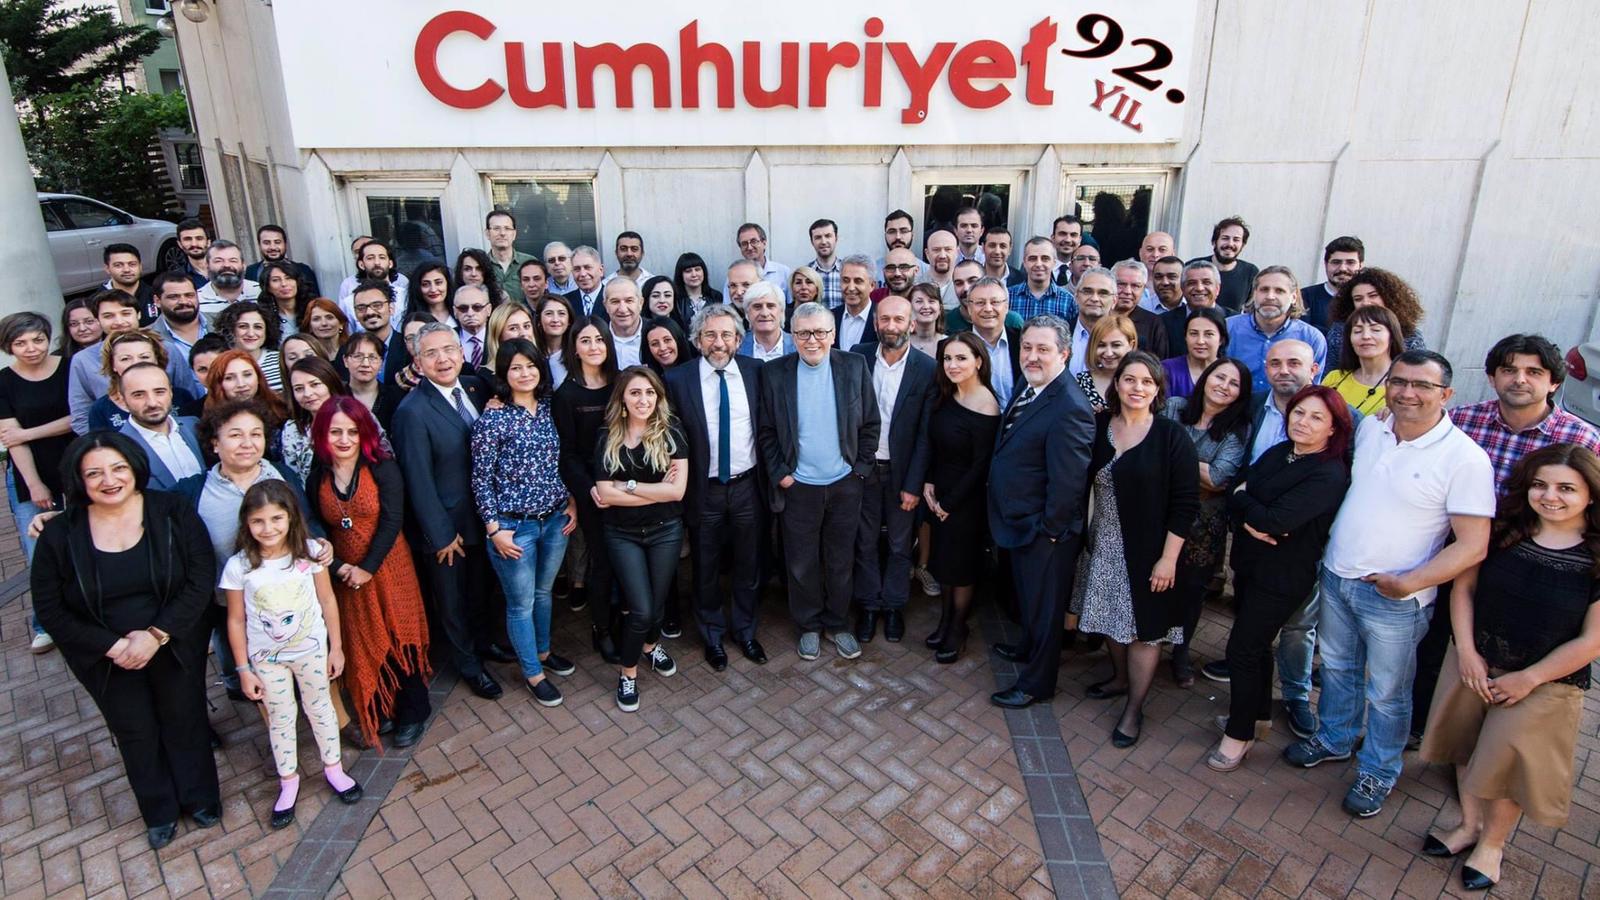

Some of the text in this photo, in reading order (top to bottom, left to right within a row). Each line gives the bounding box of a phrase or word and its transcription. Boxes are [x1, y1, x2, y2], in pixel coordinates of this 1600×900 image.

[415, 12, 1058, 124] Cumhuriyet
[1061, 13, 1185, 104] 92.
[1090, 79, 1143, 133] YIL
